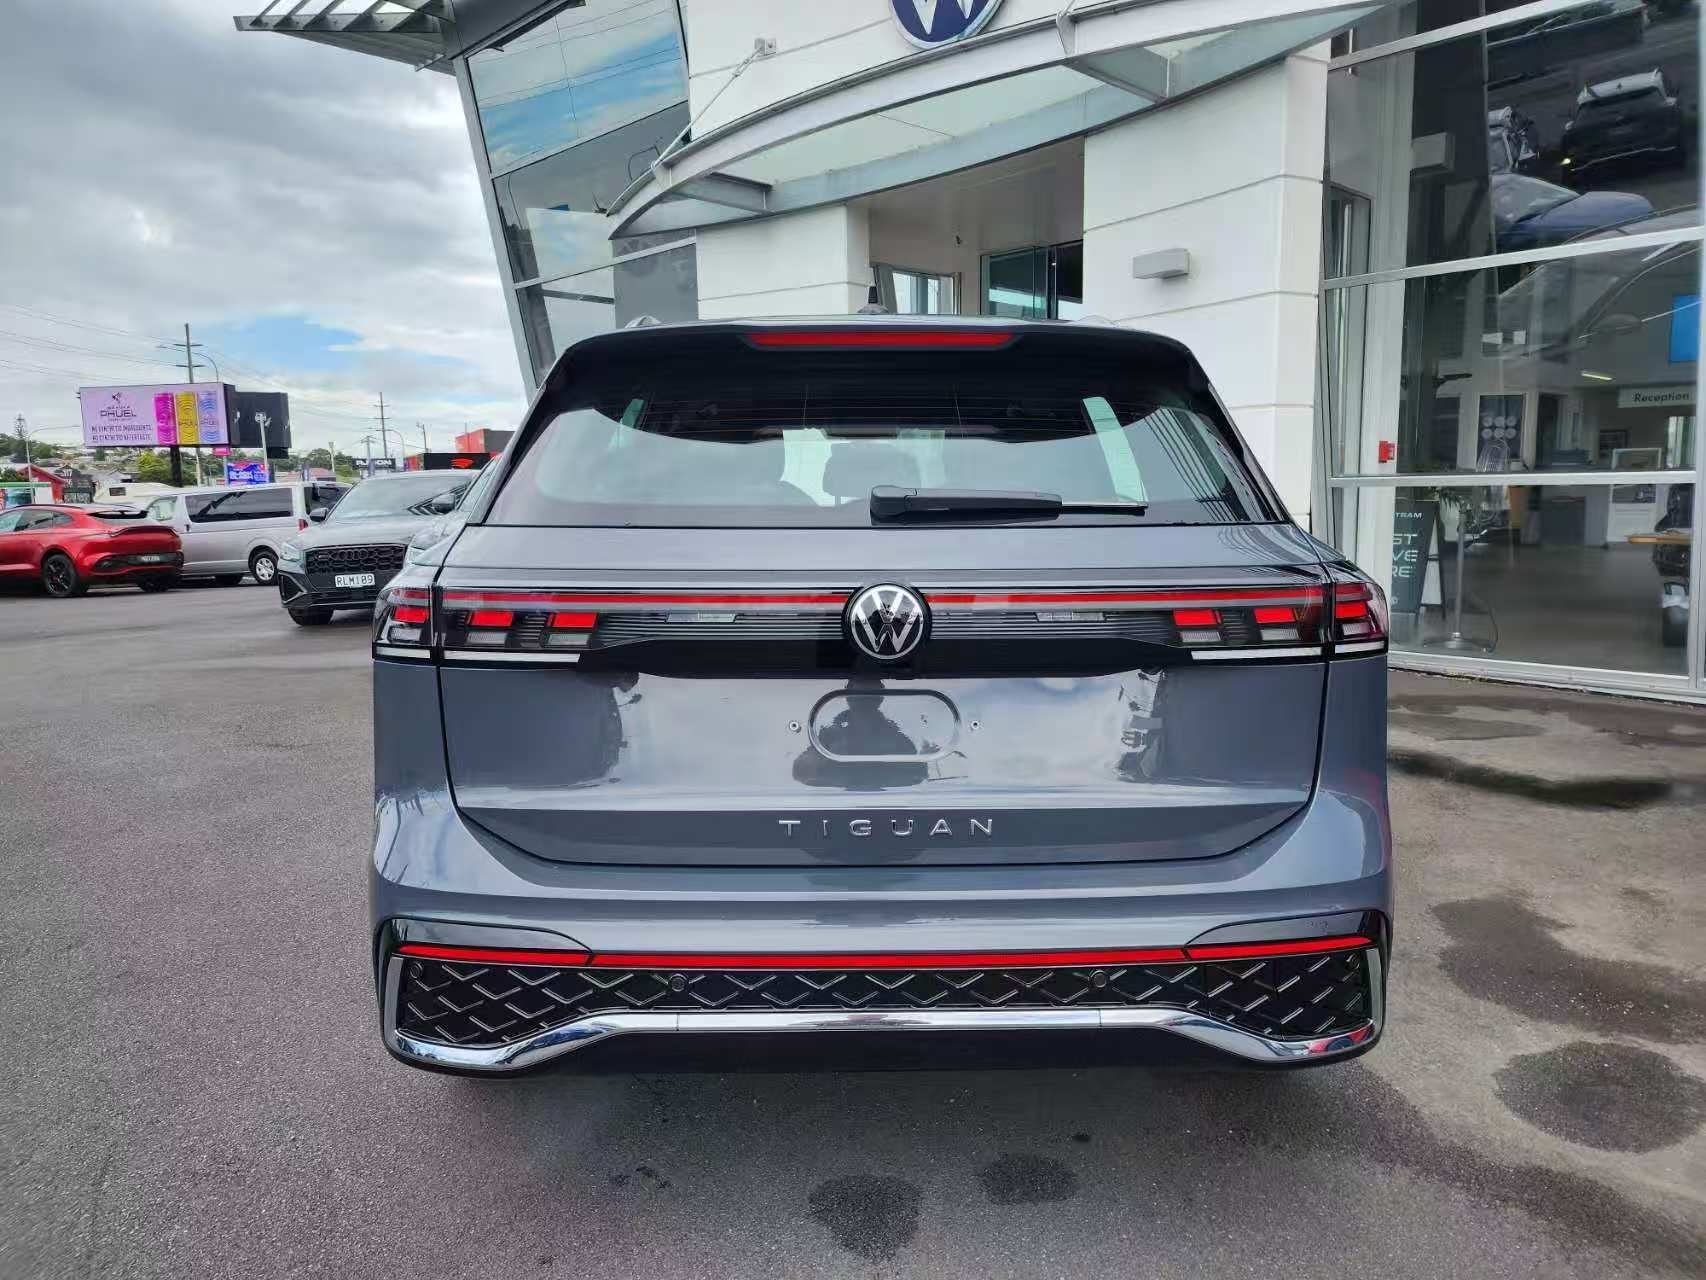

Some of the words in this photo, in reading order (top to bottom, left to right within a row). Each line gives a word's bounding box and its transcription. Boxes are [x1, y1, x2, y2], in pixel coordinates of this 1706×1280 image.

[1634, 391, 1689, 403] Reception
[336, 575, 374, 586] RLM189
[778, 818, 994, 837] TIGUAN
